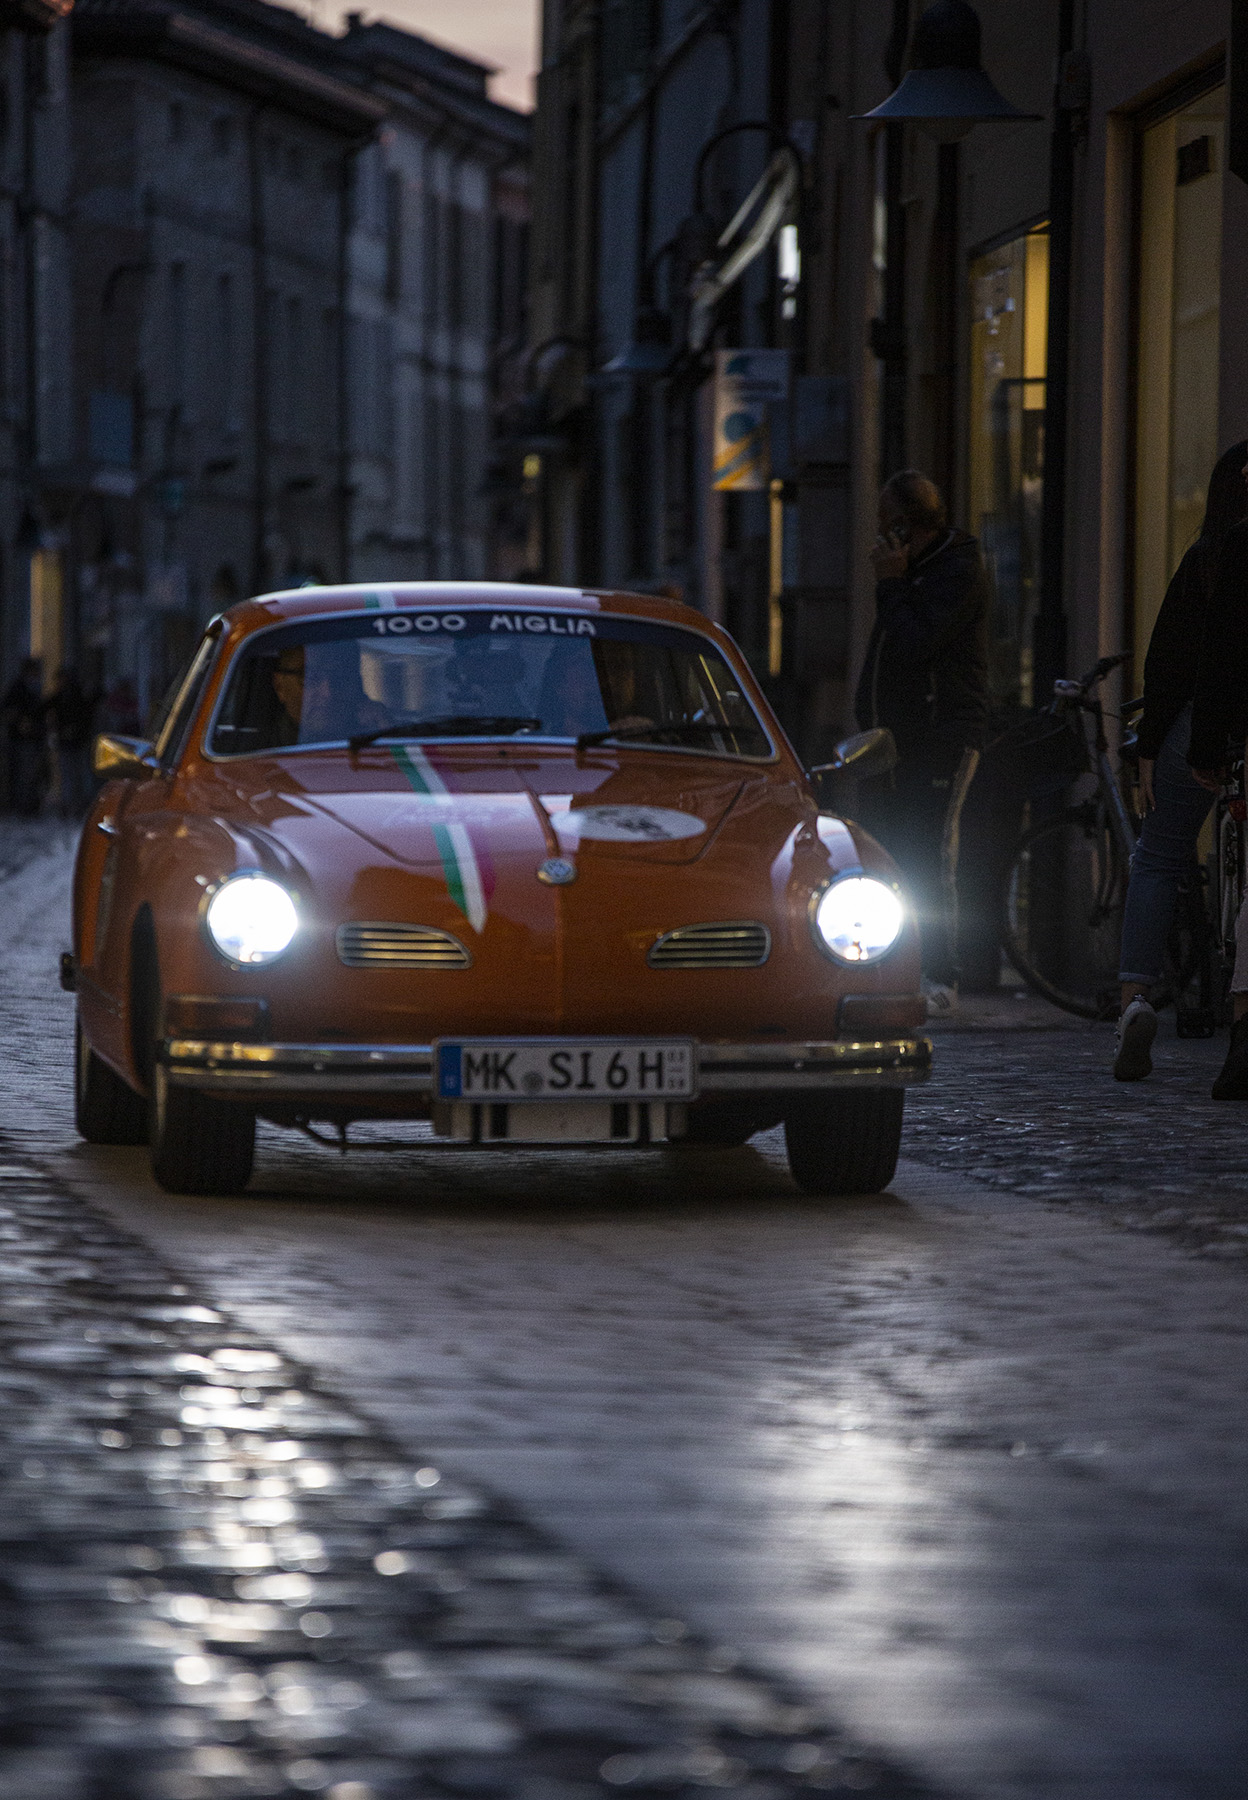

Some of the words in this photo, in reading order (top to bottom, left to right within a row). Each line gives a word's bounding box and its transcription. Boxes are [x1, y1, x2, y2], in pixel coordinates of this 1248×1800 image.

[373, 614, 467, 635] 1000
[489, 614, 597, 637] MIGLIA
[465, 1052, 516, 1090] MK
